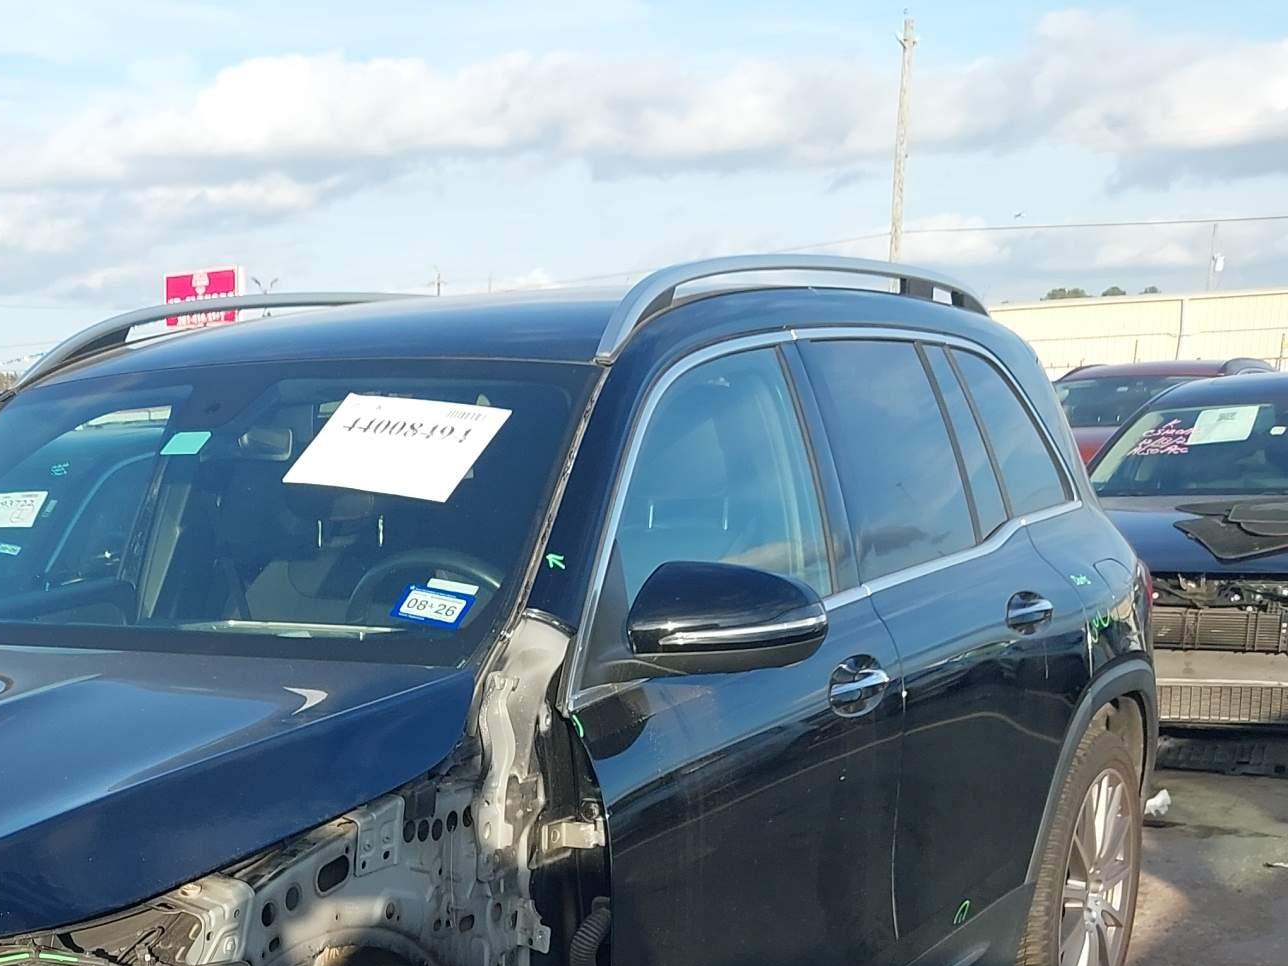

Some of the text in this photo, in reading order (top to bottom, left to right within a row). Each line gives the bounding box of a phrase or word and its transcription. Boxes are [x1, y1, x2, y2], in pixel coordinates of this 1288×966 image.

[343, 416, 472, 443] 44008494
[406, 598, 429, 611] 08
[433, 603, 458, 617] 26
